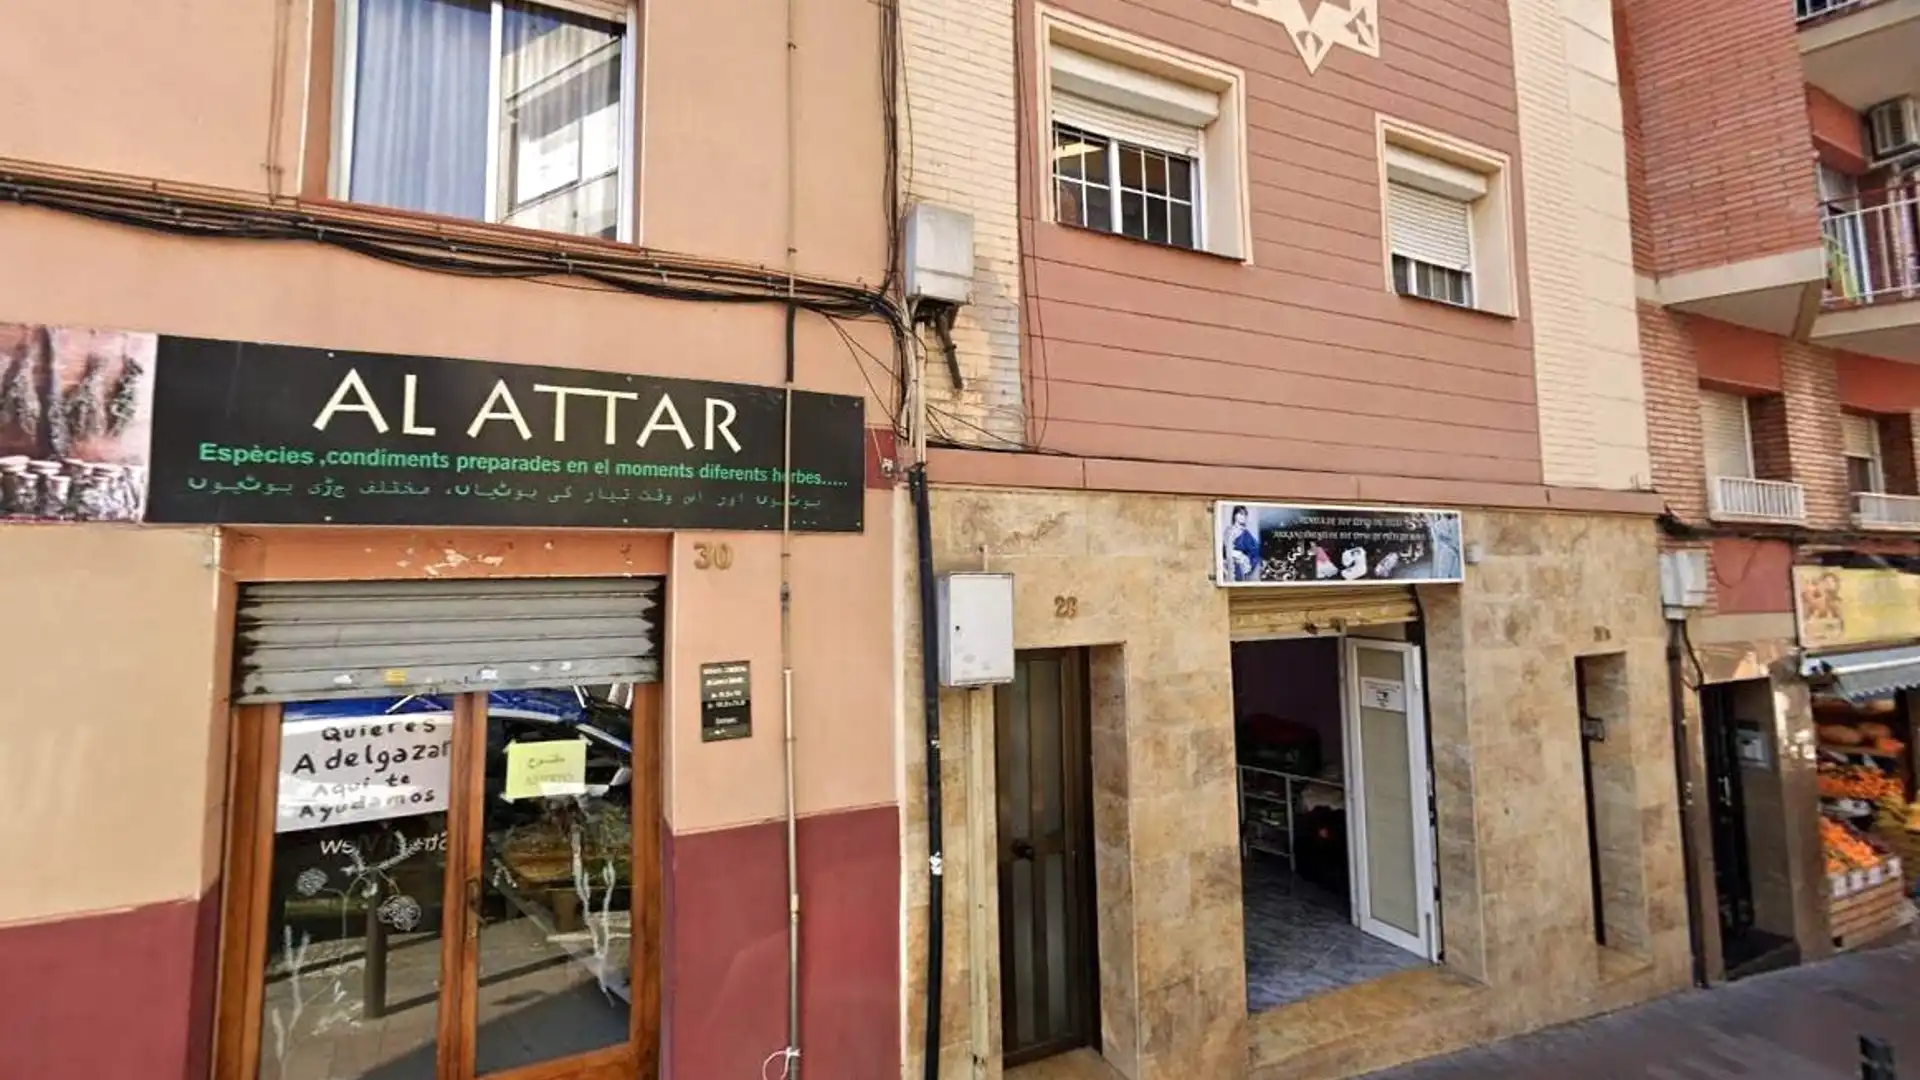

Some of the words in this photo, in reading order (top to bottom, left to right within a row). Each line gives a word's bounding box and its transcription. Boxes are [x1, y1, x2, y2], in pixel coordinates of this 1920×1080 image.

[312, 367, 437, 435] AL
[465, 379, 742, 454] ATTAR
[199, 441, 314, 466] Espècies
[455, 453, 561, 474] preparades
[567, 461, 588, 475] en
[595, 458, 610, 475] el
[615, 462, 694, 479] moments
[699, 462, 768, 482] diferents
[693, 541, 734, 570] 30
[321, 721, 437, 743] Quieres
[385, 773, 411, 787] te
[299, 789, 436, 823] Ayudamos
